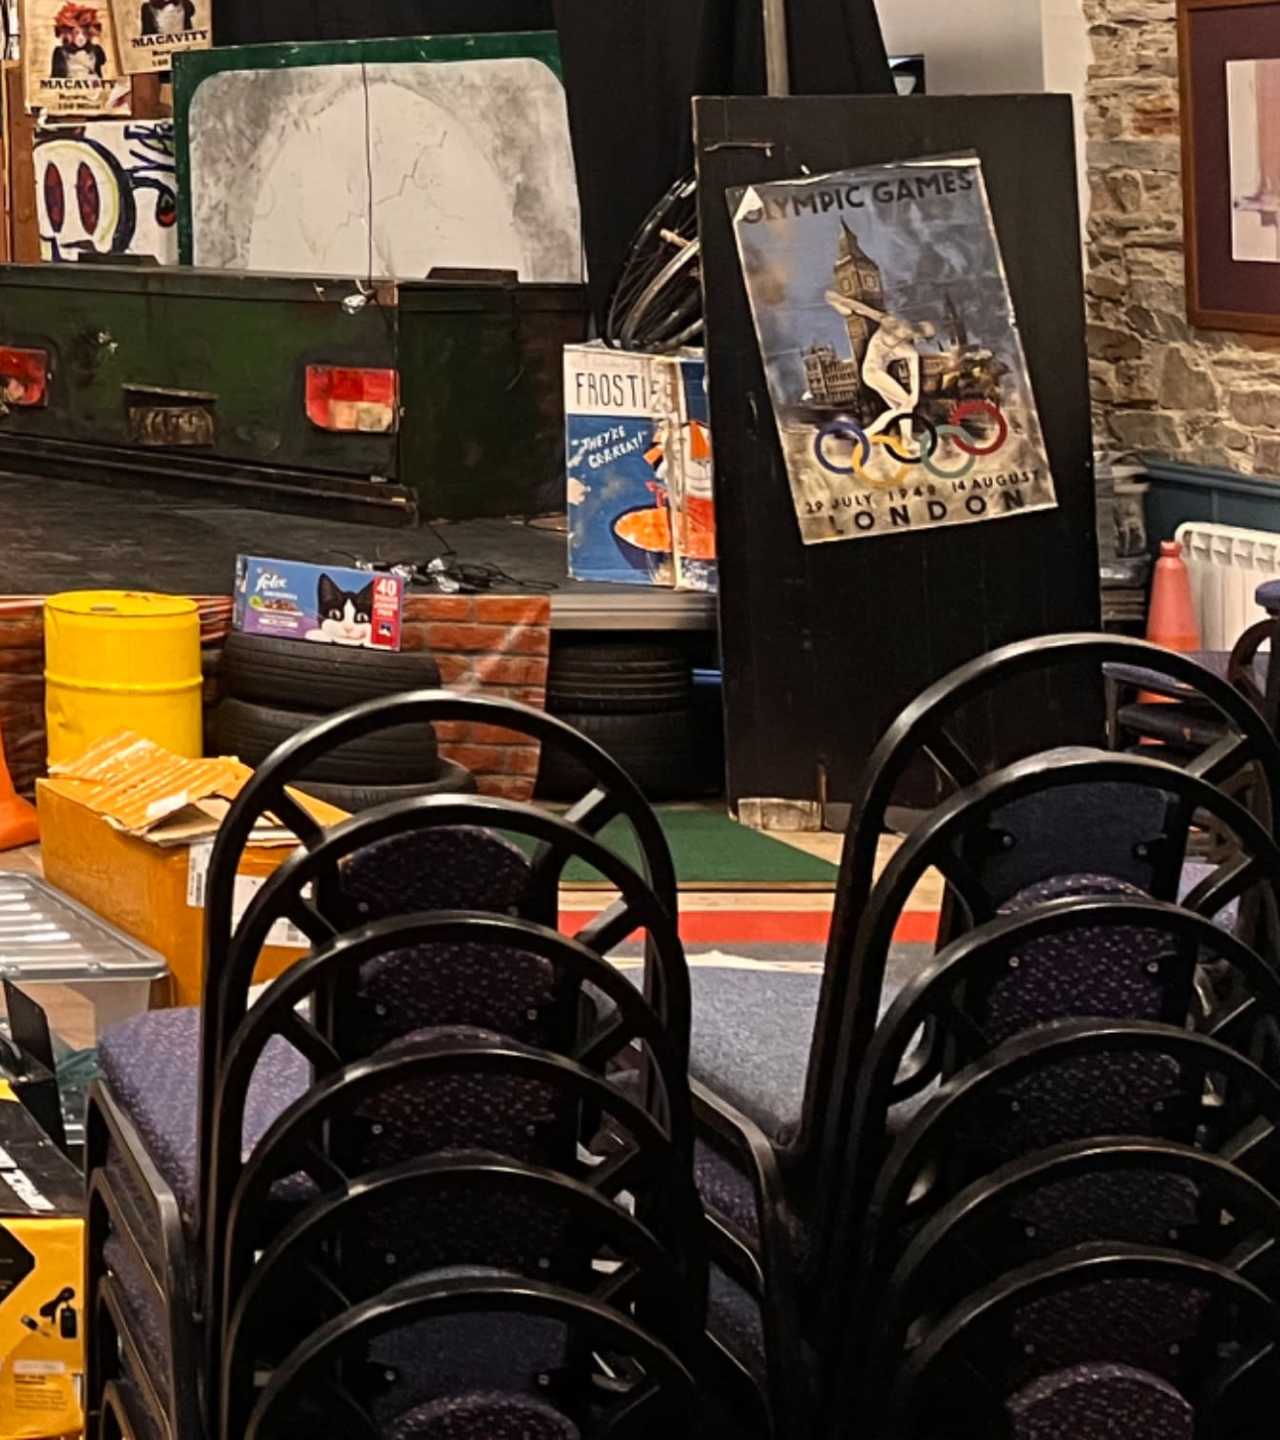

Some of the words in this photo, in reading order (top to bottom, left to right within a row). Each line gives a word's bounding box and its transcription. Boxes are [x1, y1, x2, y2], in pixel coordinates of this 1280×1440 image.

[130, 29, 209, 49] MACAVITY
[40, 78, 118, 91] MACAVTY
[872, 170, 973, 205] GAMES
[831, 494, 872, 510] JULY
[951, 481, 966, 493] 14
[971, 468, 1040, 490] AUGUST
[828, 488, 1025, 535] LONDON
[376, 578, 398, 597] 40
